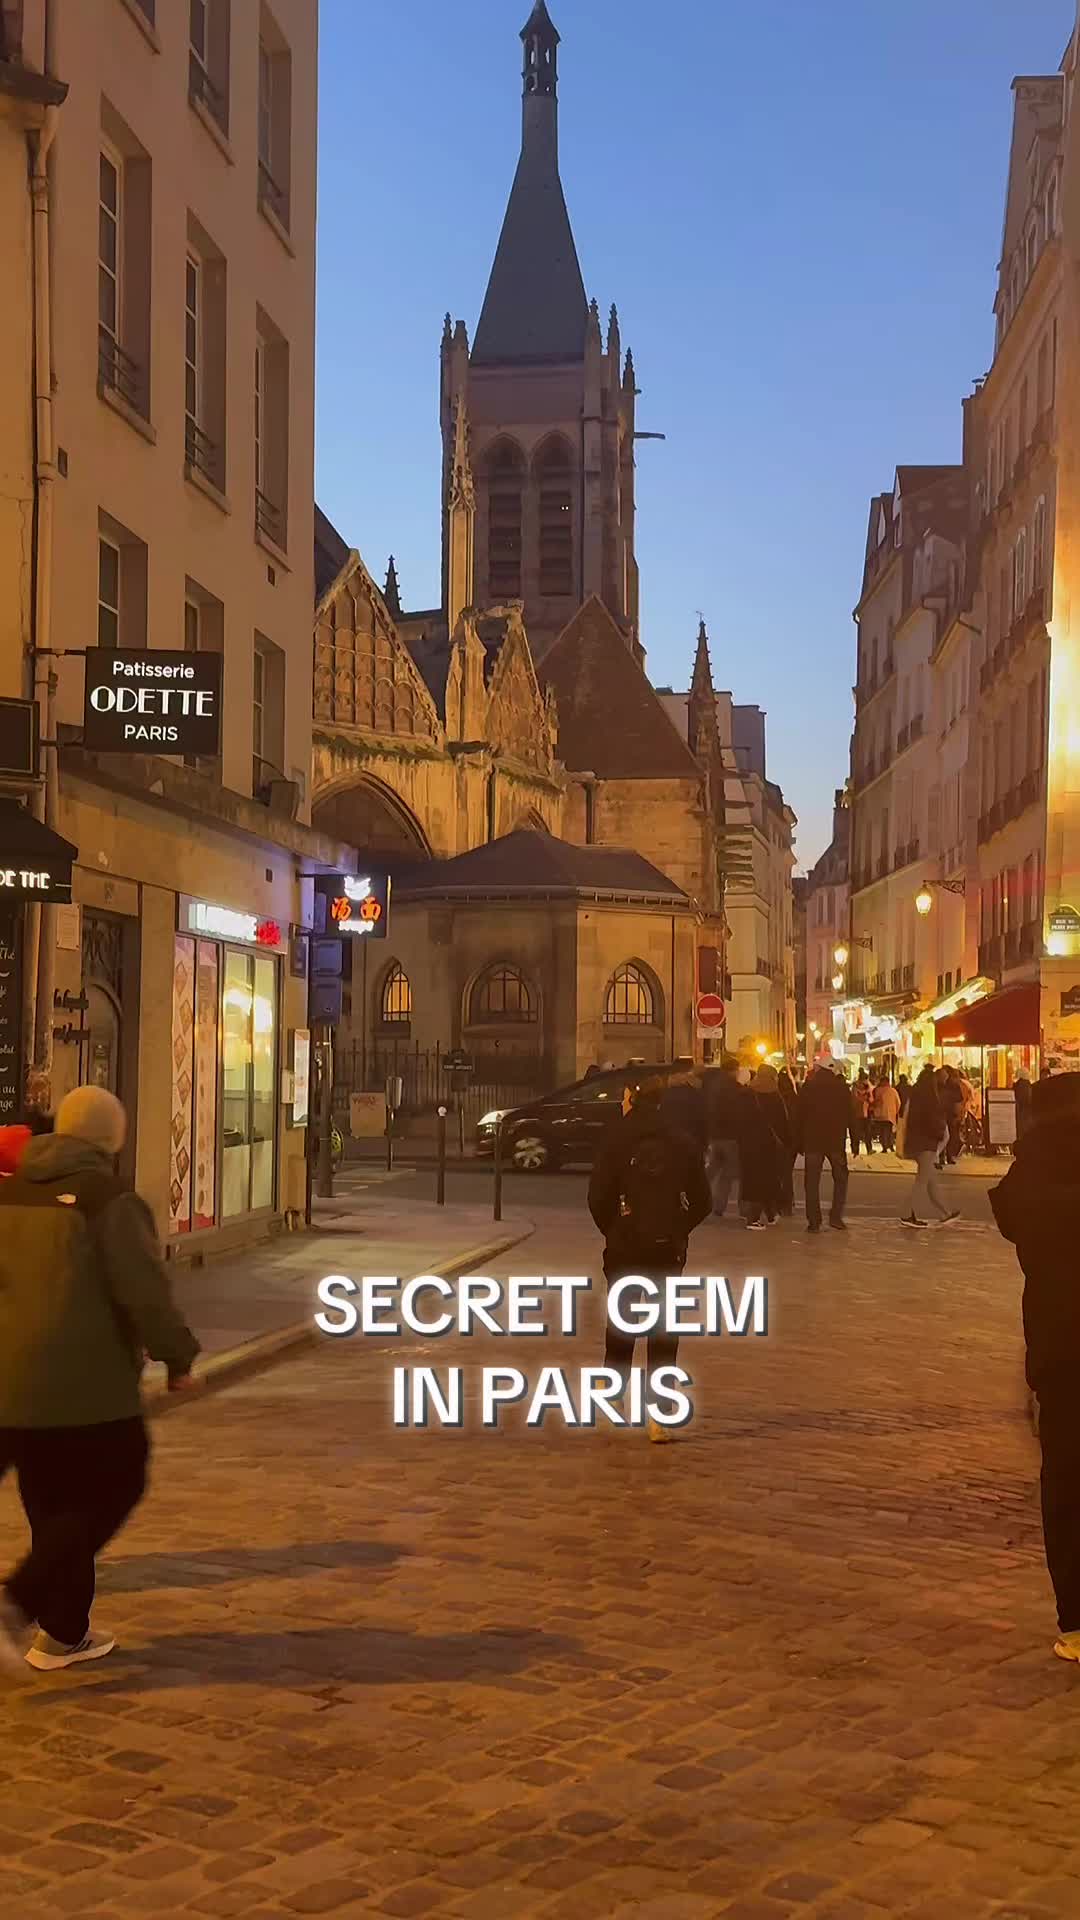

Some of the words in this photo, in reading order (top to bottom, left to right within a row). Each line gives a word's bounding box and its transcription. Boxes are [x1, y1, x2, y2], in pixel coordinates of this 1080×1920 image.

[113, 661, 194, 678] Patisserie
[91, 686, 213, 716] ODETTE
[125, 725, 177, 740] PARIS
